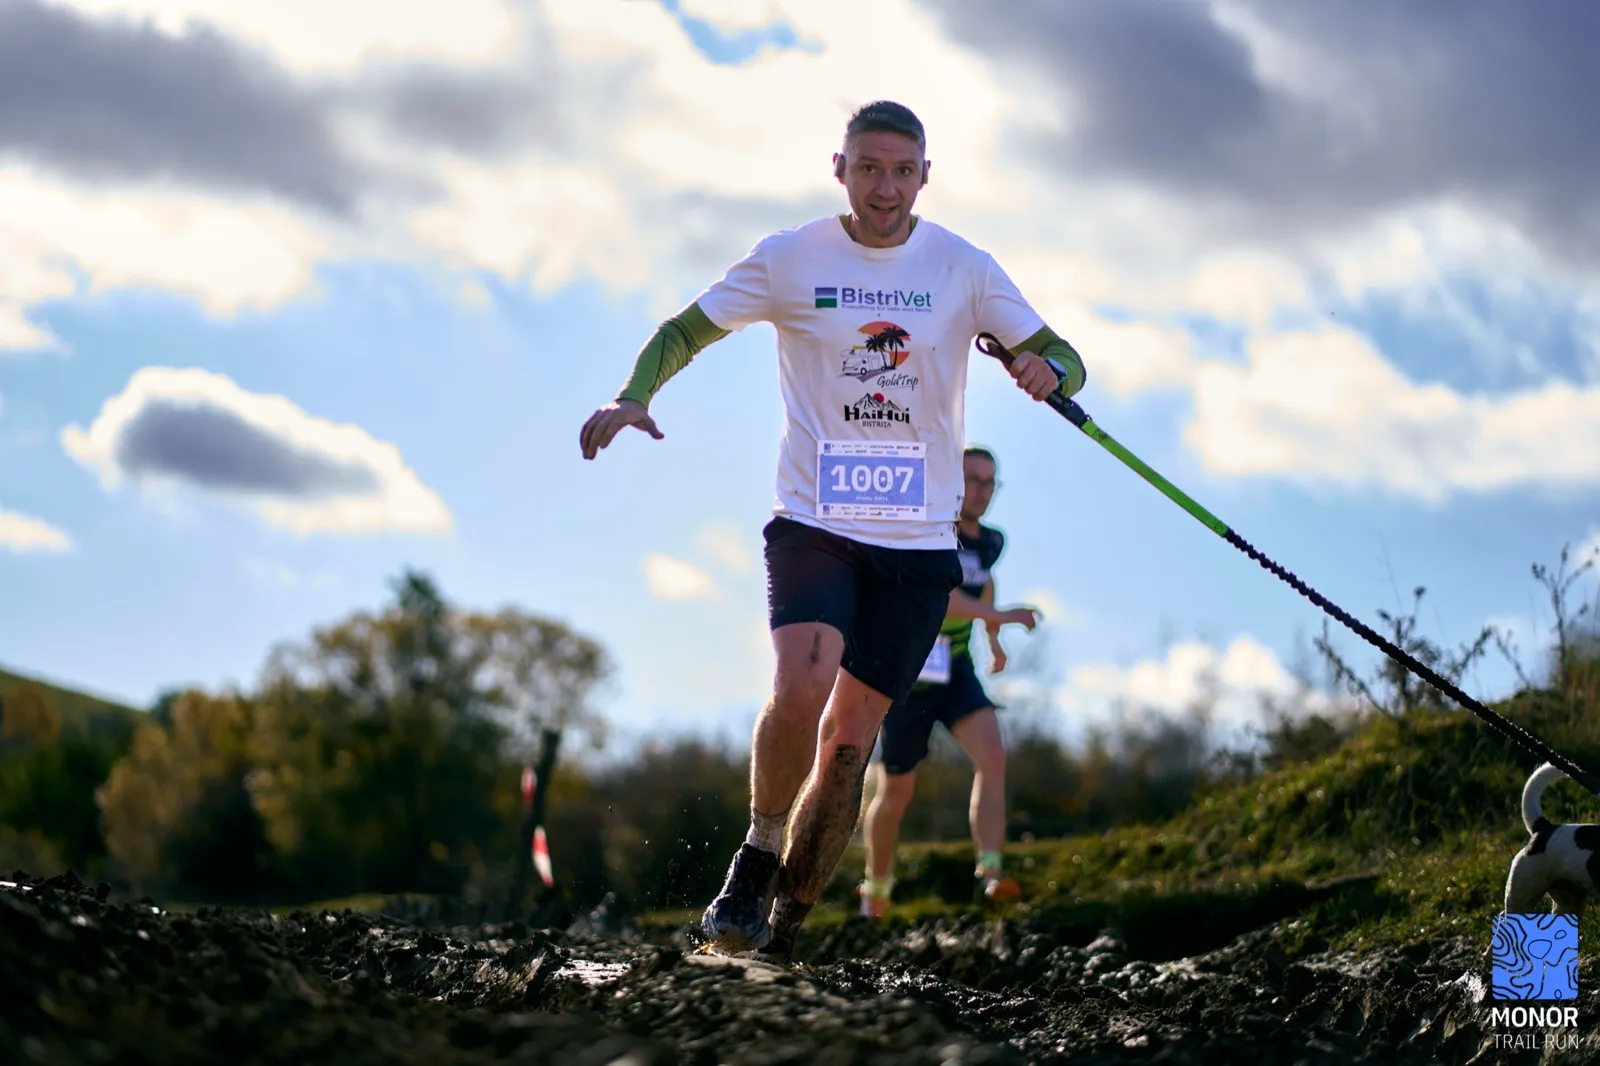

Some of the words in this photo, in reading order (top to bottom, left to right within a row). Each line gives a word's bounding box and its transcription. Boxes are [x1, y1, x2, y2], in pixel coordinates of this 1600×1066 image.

[841, 287, 932, 307] BistriVet
[841, 303, 875, 311] Everything
[830, 464, 914, 494] 1007
